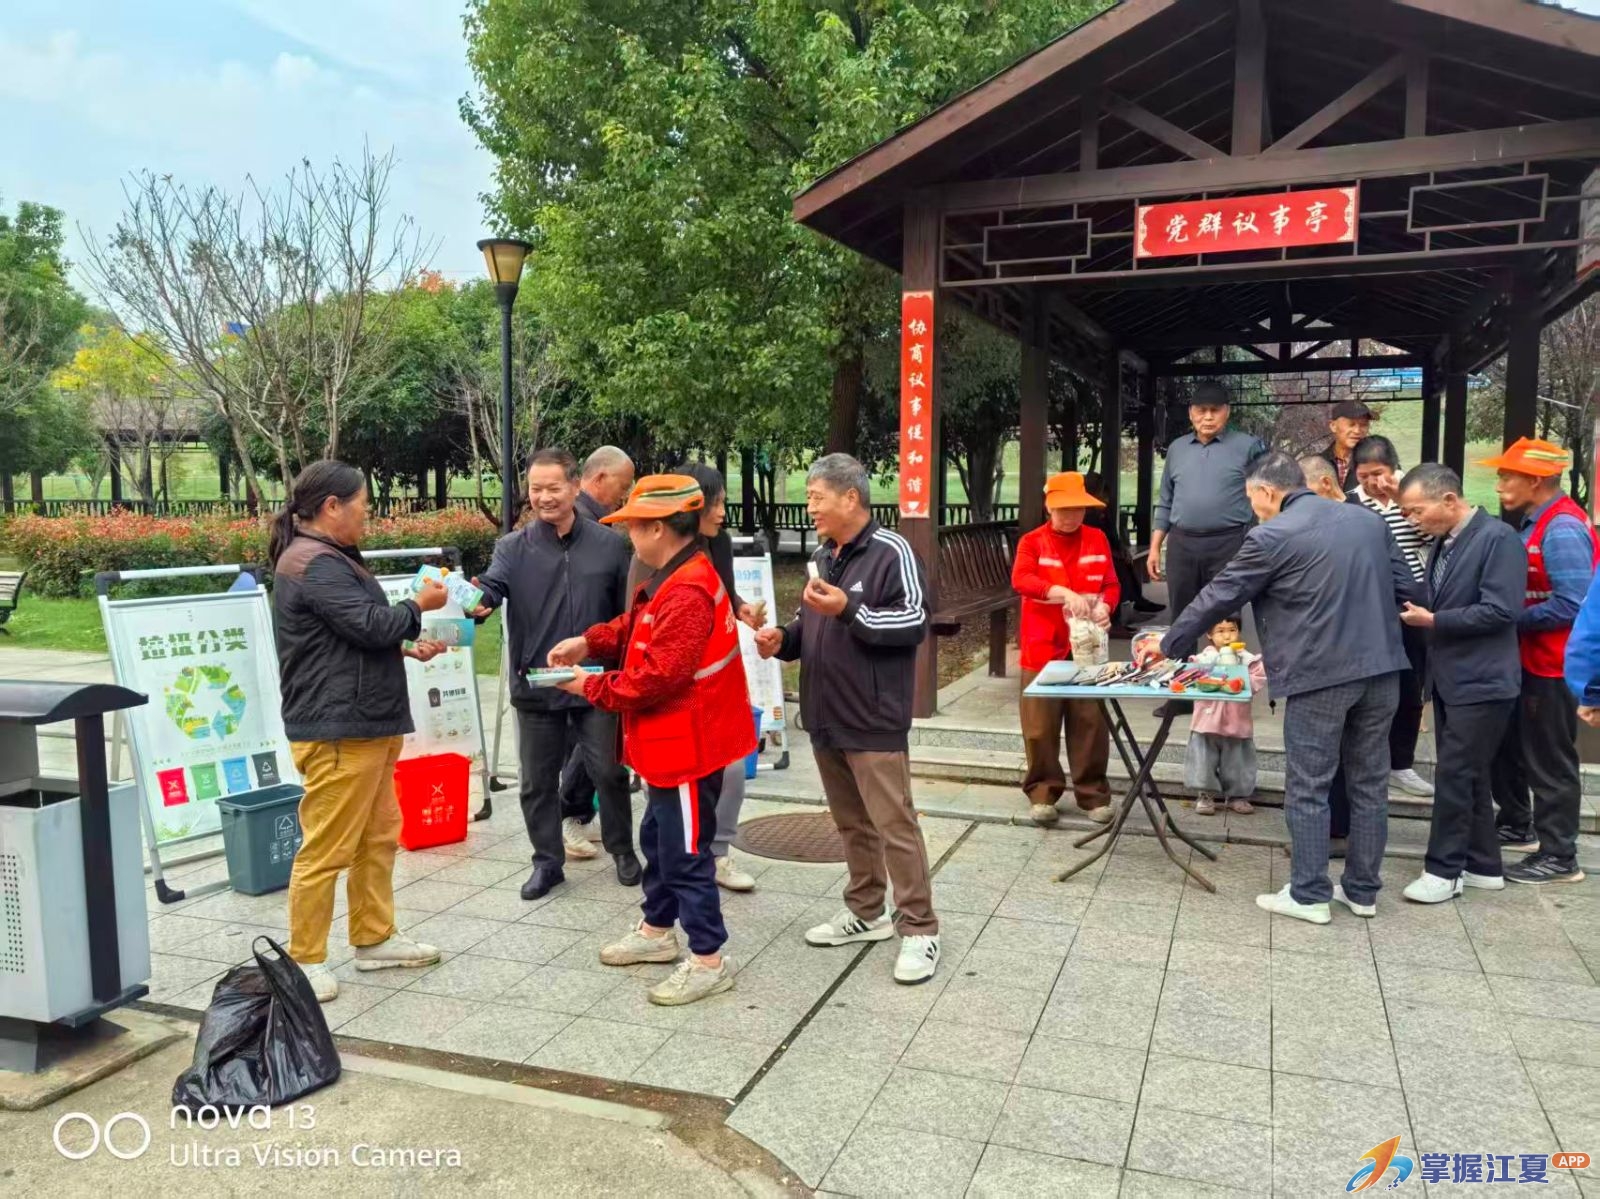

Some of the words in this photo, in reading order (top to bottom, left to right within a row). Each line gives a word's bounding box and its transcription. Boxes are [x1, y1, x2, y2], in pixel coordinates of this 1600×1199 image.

[1166, 201, 1328, 243] 党群议事亭
[907, 318, 928, 494] 协商议事促和谐
[139, 627, 249, 660] 垃圾分类
